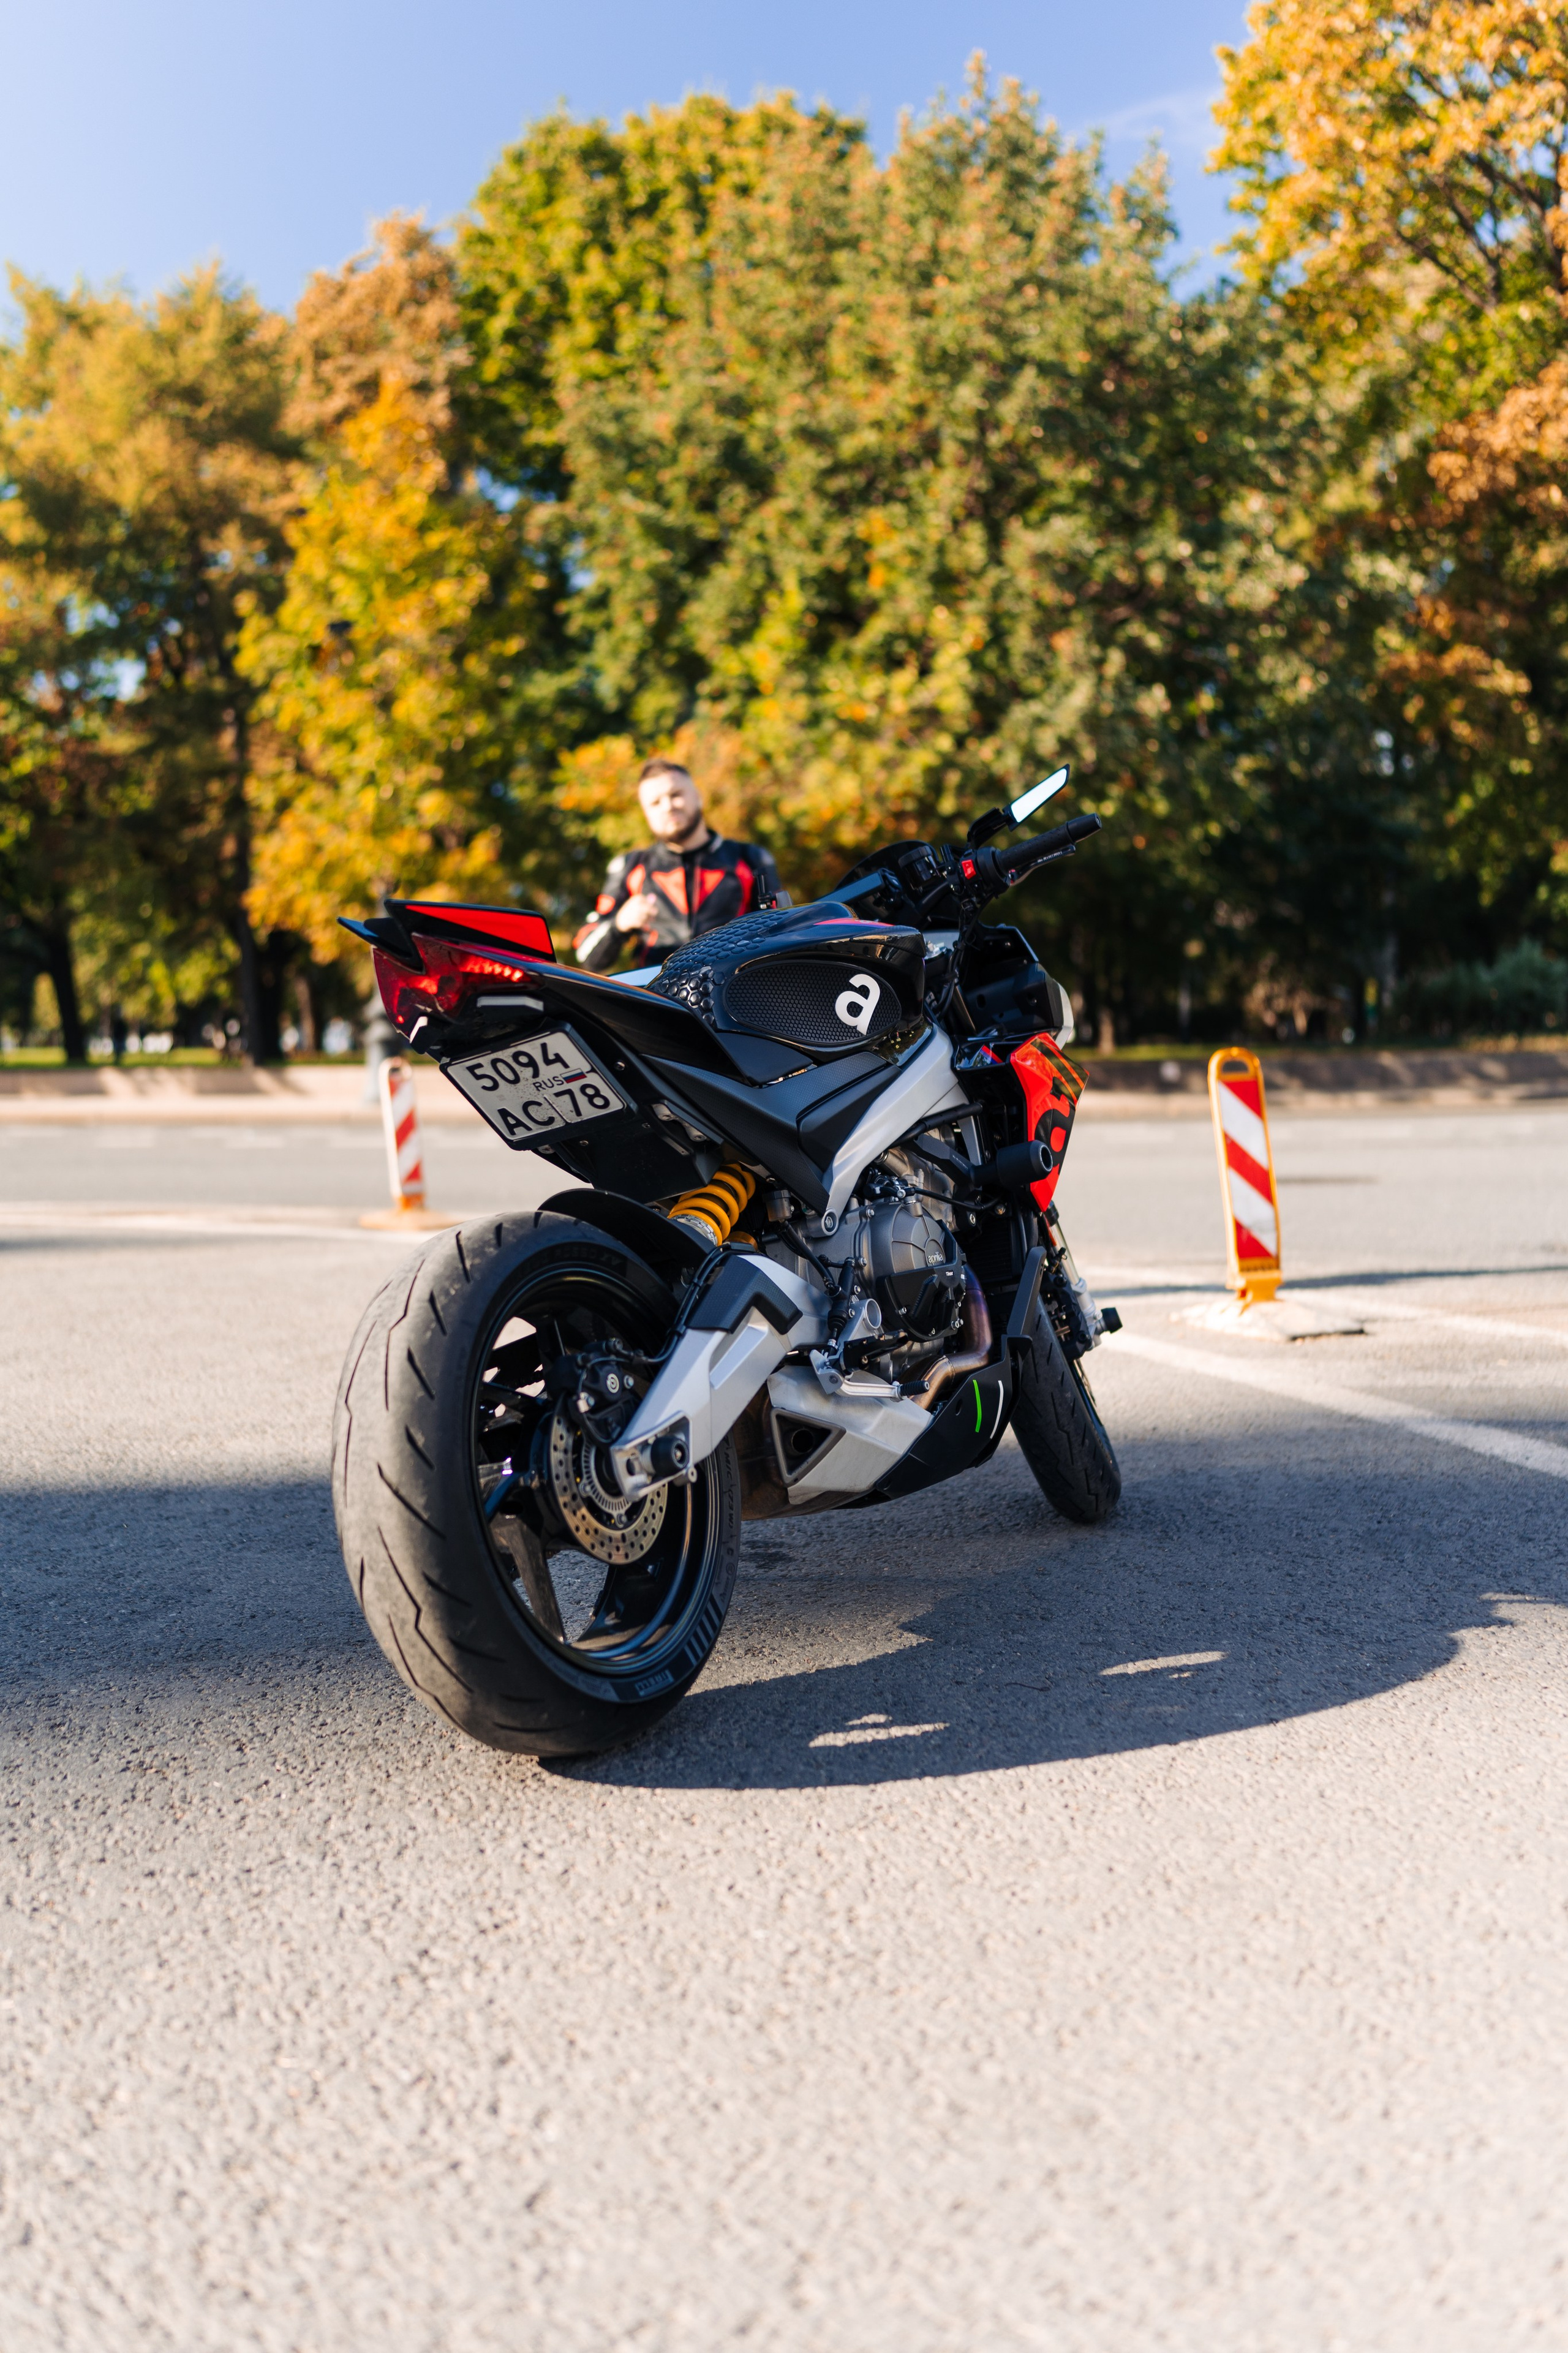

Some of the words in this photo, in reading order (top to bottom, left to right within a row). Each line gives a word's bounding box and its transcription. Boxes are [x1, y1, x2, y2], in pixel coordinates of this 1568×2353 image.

[835, 973, 881, 1035] a
[466, 1042, 570, 1092] 5094
[532, 1076, 565, 1092] RUS
[497, 1100, 556, 1136] AC
[553, 1083, 611, 1117] 78
